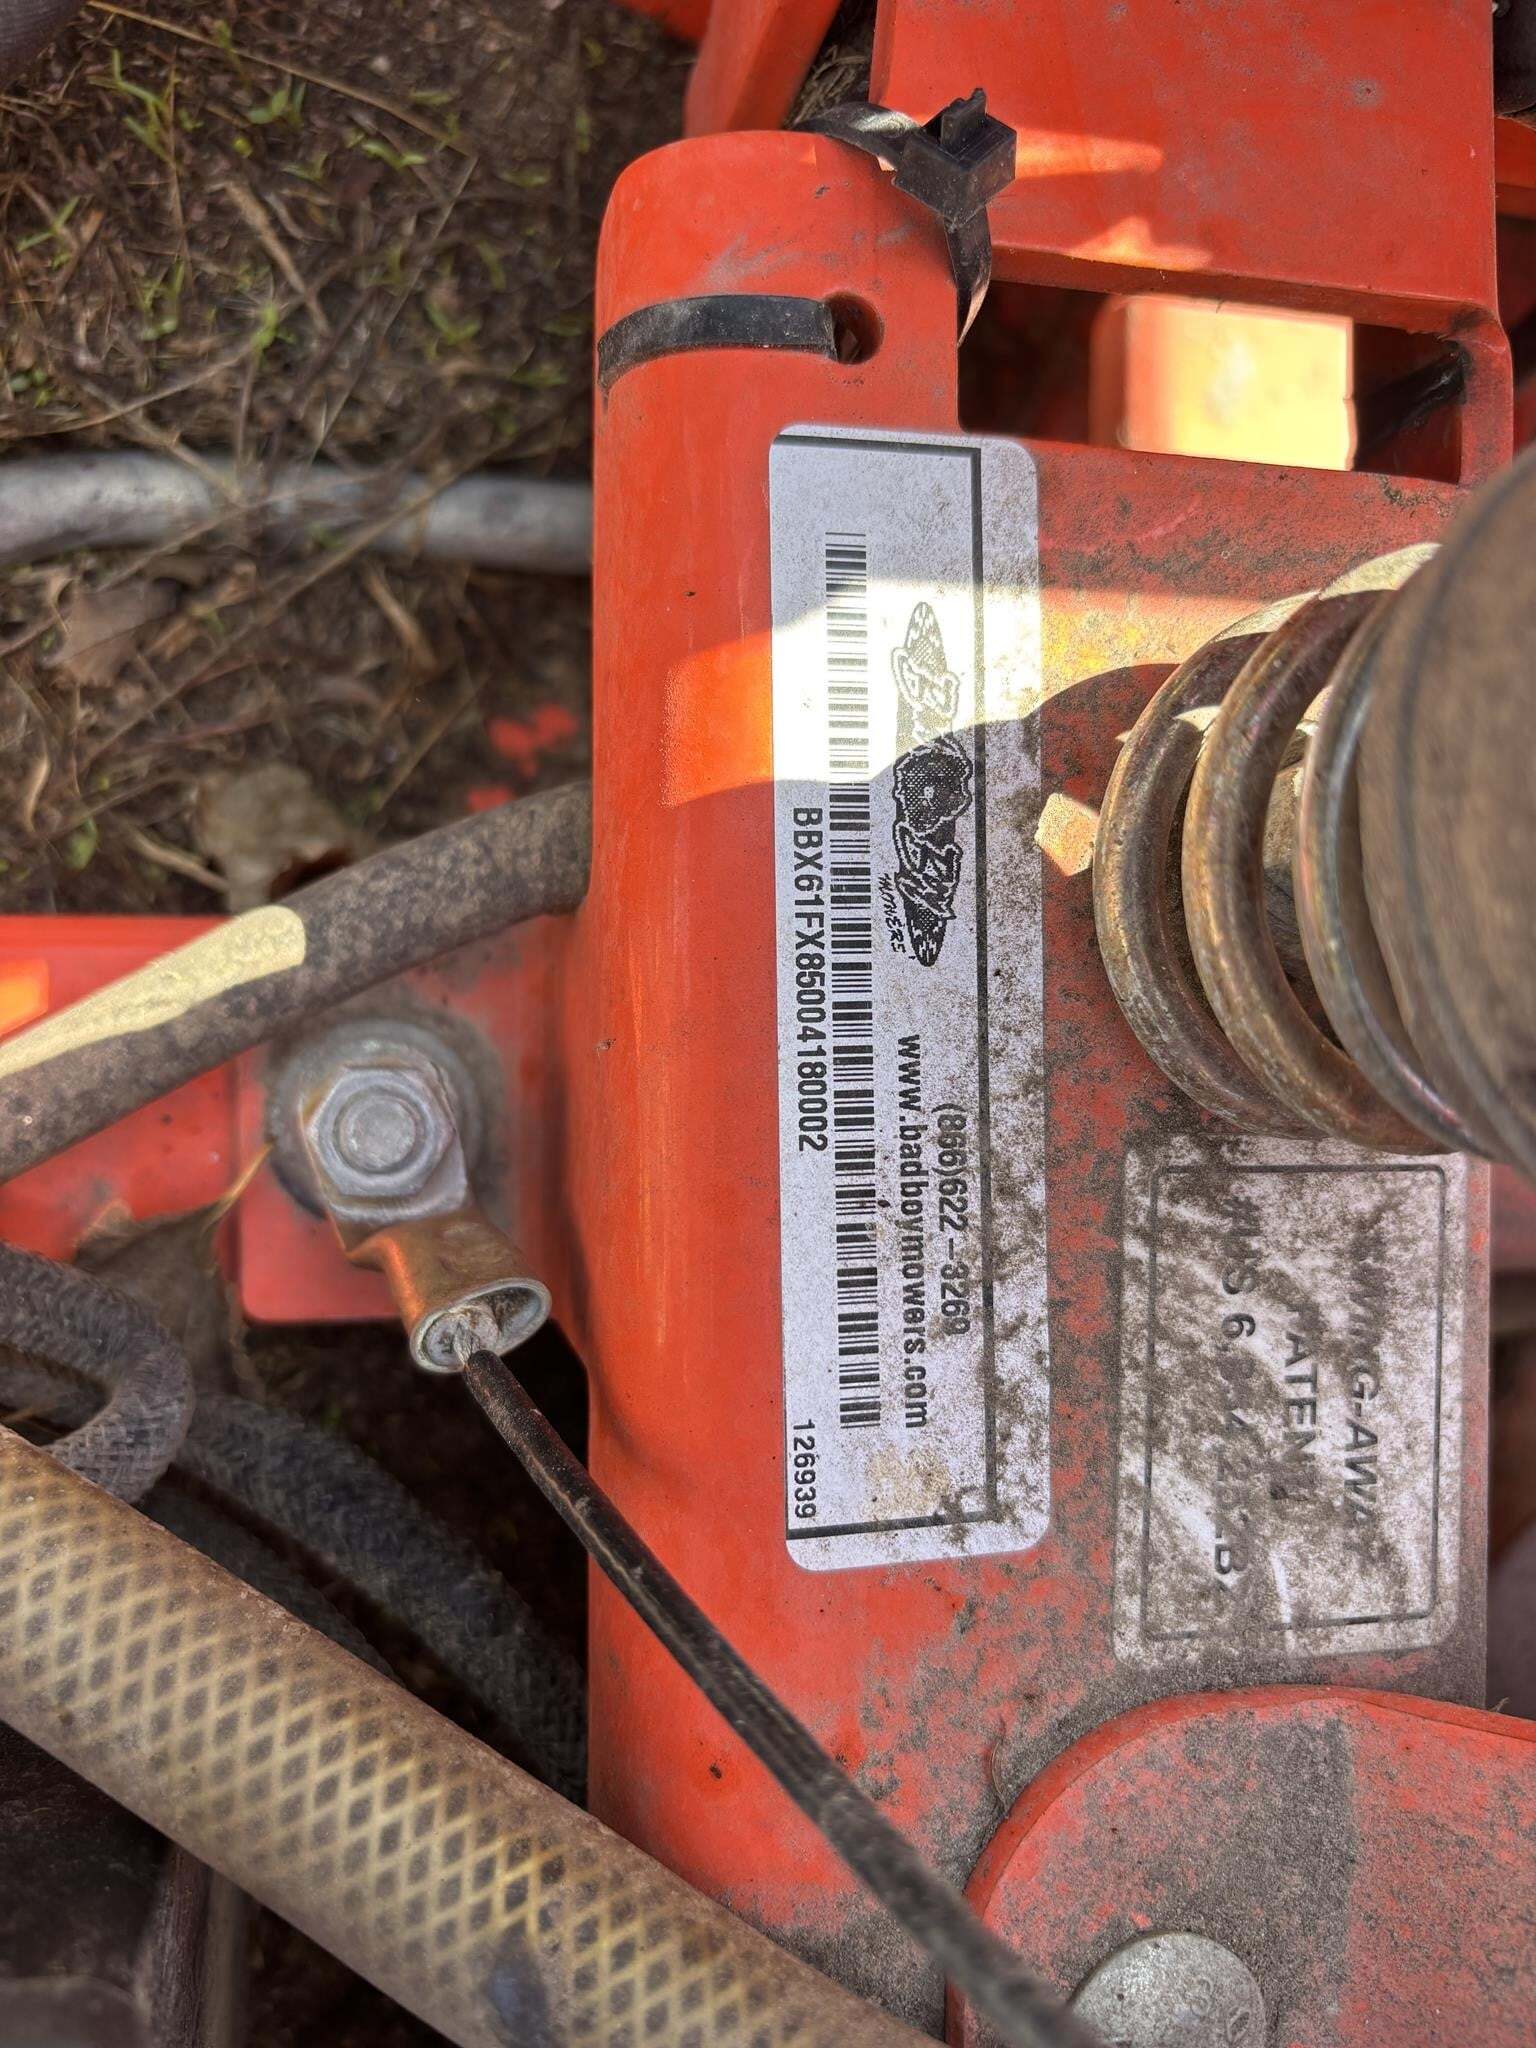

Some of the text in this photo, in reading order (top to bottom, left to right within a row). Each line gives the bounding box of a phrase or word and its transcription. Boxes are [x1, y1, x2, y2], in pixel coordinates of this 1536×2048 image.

[793, 807, 828, 1152] BBX61FX85004180002
[896, 1034, 929, 1429] www.badboymowers.com
[793, 1419, 817, 1519] 126939
